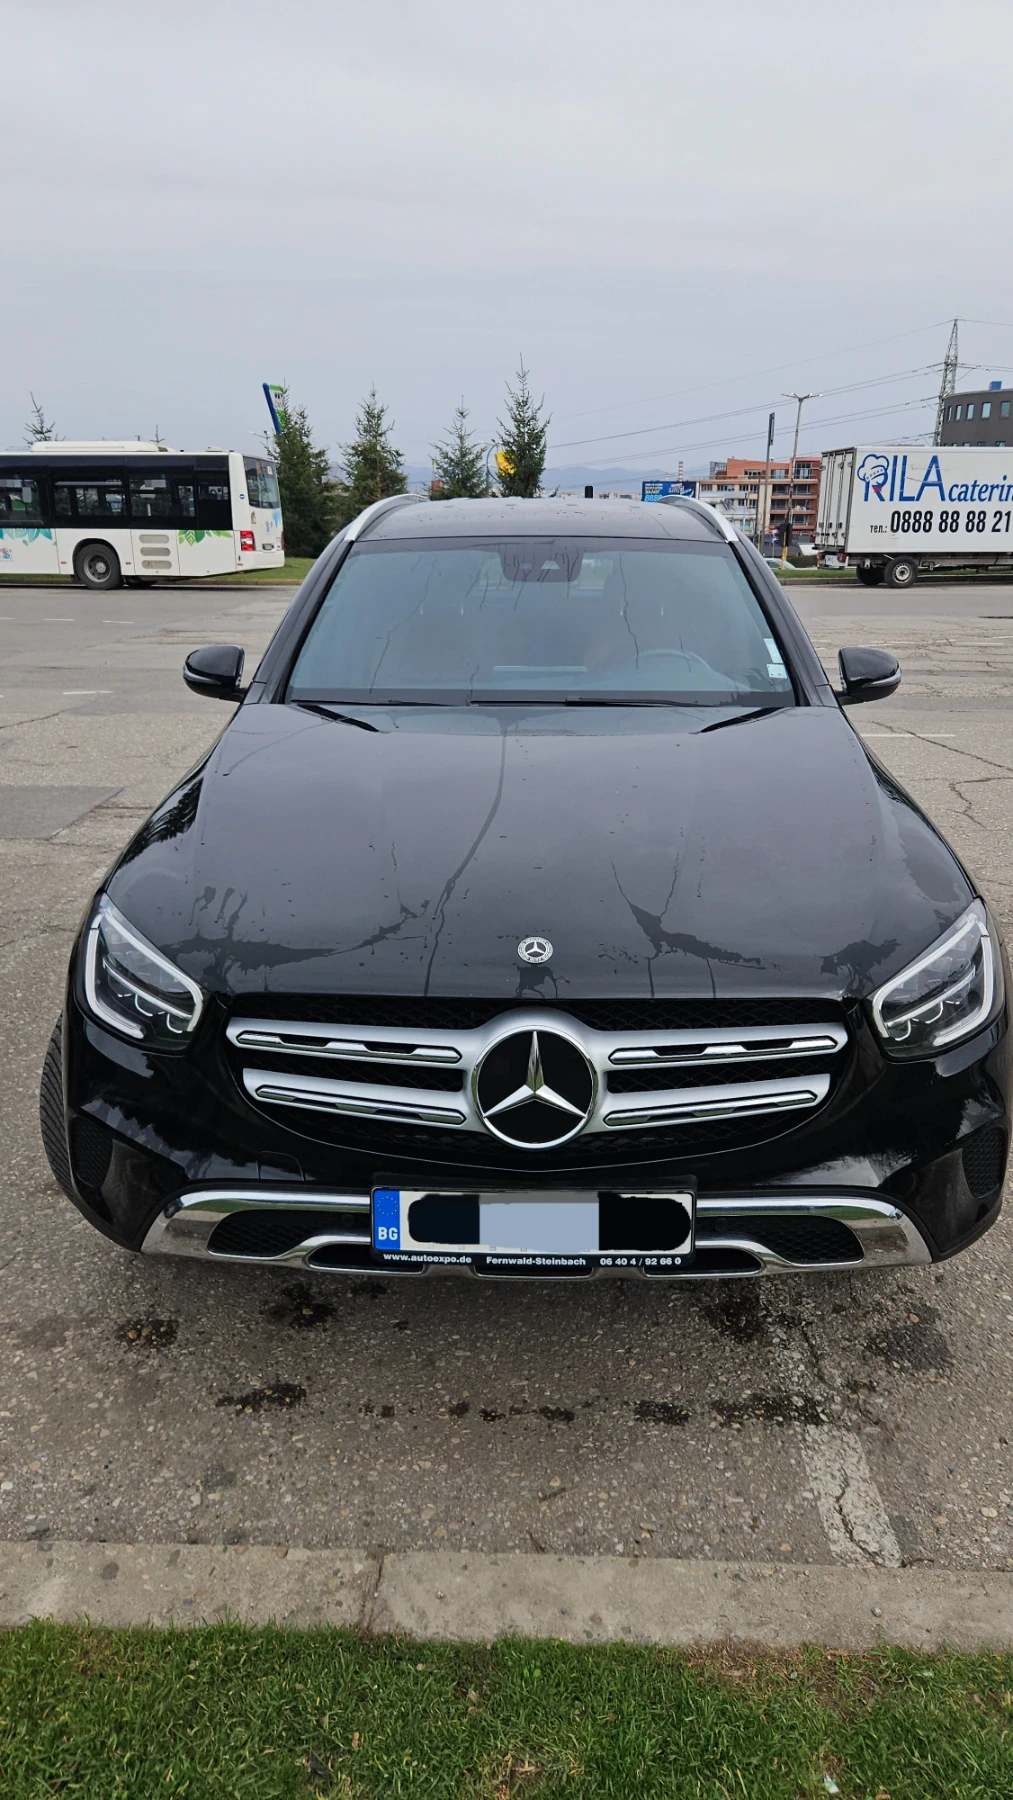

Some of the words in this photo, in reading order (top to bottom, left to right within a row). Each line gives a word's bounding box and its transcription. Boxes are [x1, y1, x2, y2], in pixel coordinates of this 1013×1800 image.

[858, 454, 946, 502] RILA
[890, 510, 934, 533] 0888
[938, 510, 960, 533] 88
[965, 510, 987, 533] 88
[991, 510, 1011, 533] 21
[378, 1226, 398, 1241] BG
[383, 1253, 472, 1264] www.autoexpo.de
[486, 1256, 586, 1265] Fernwald-Steinbach
